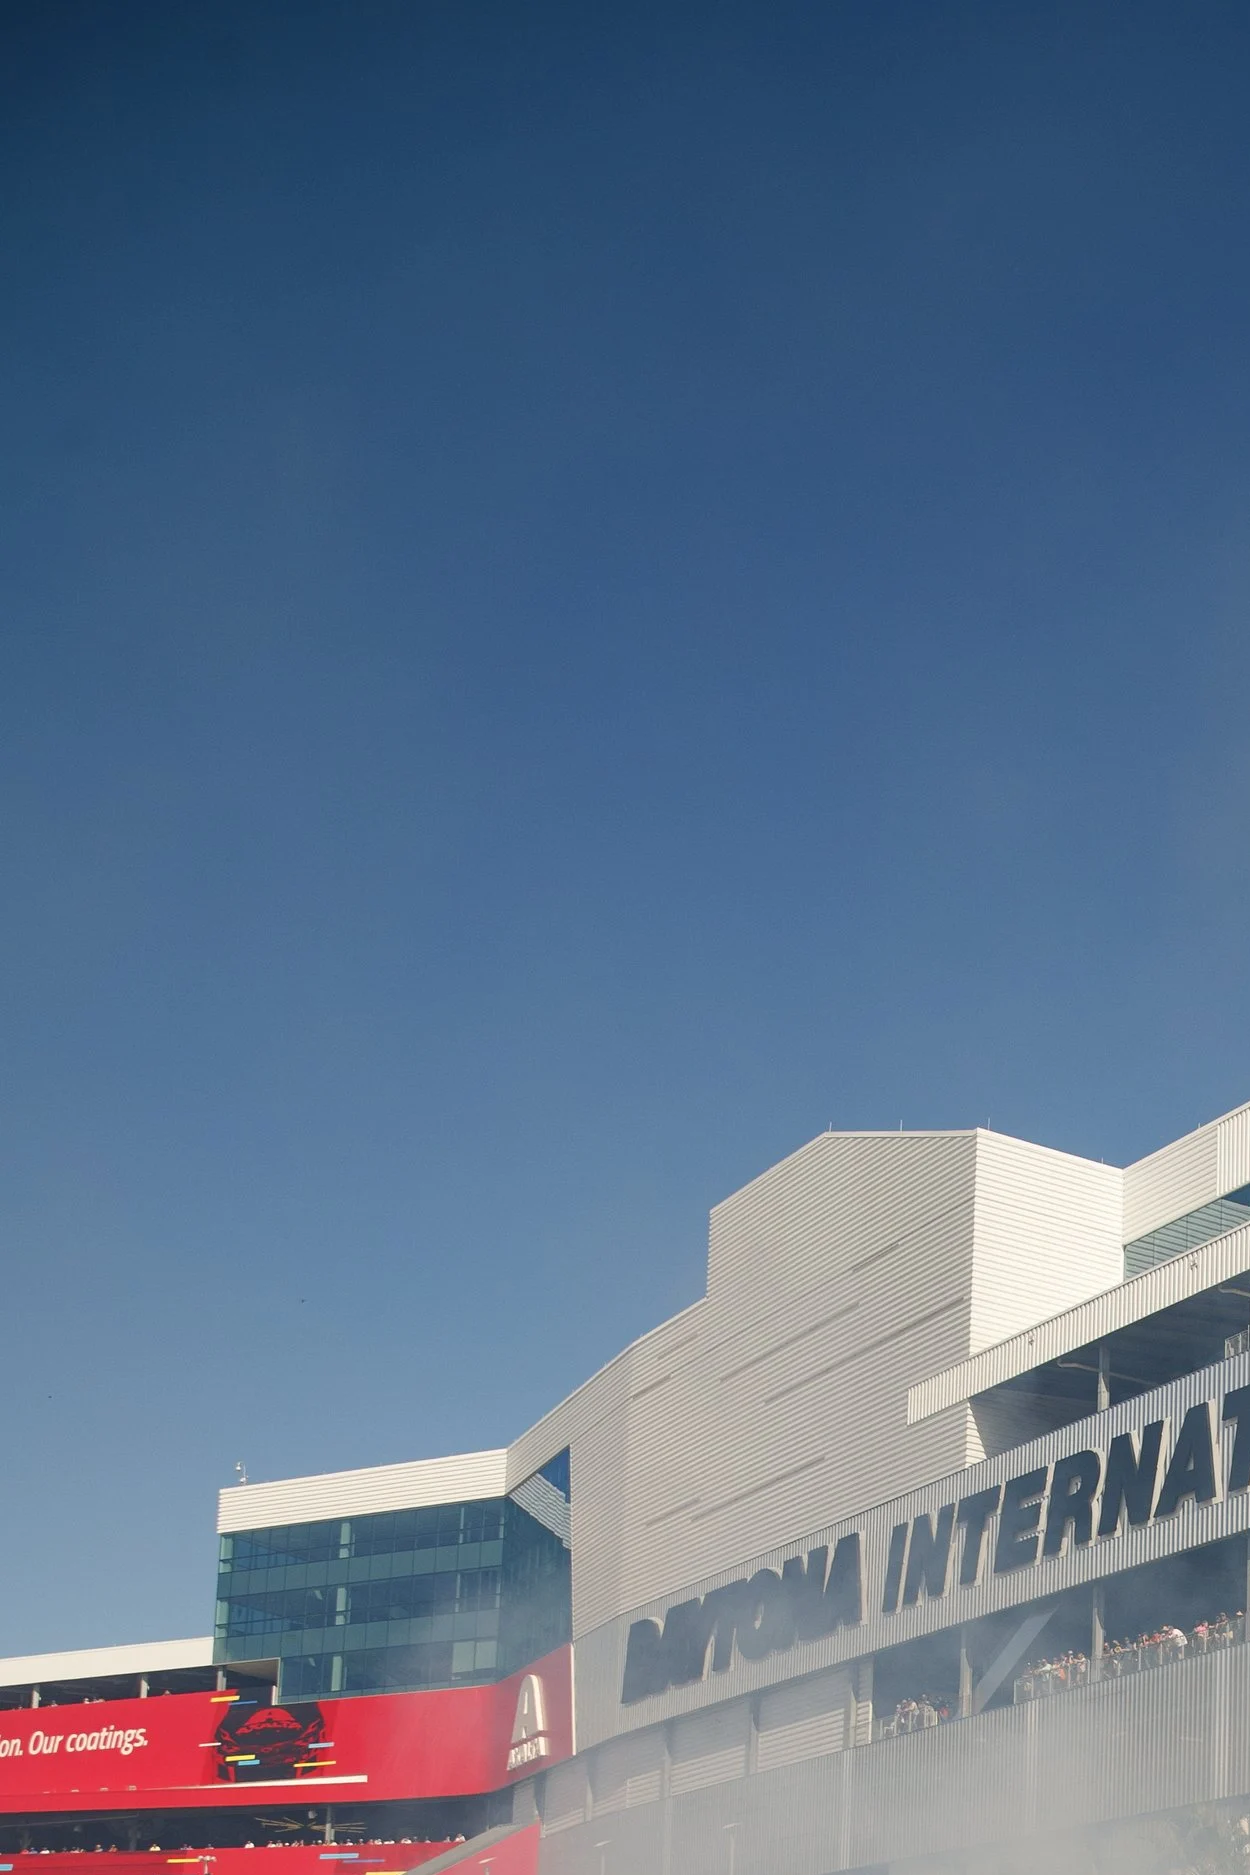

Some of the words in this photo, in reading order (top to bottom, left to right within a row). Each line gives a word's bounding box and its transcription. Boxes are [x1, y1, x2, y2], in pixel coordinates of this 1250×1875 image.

[0, 1736, 24, 1758] on.
[28, 1730, 64, 1756] Our
[65, 1724, 149, 1756] coatings.
